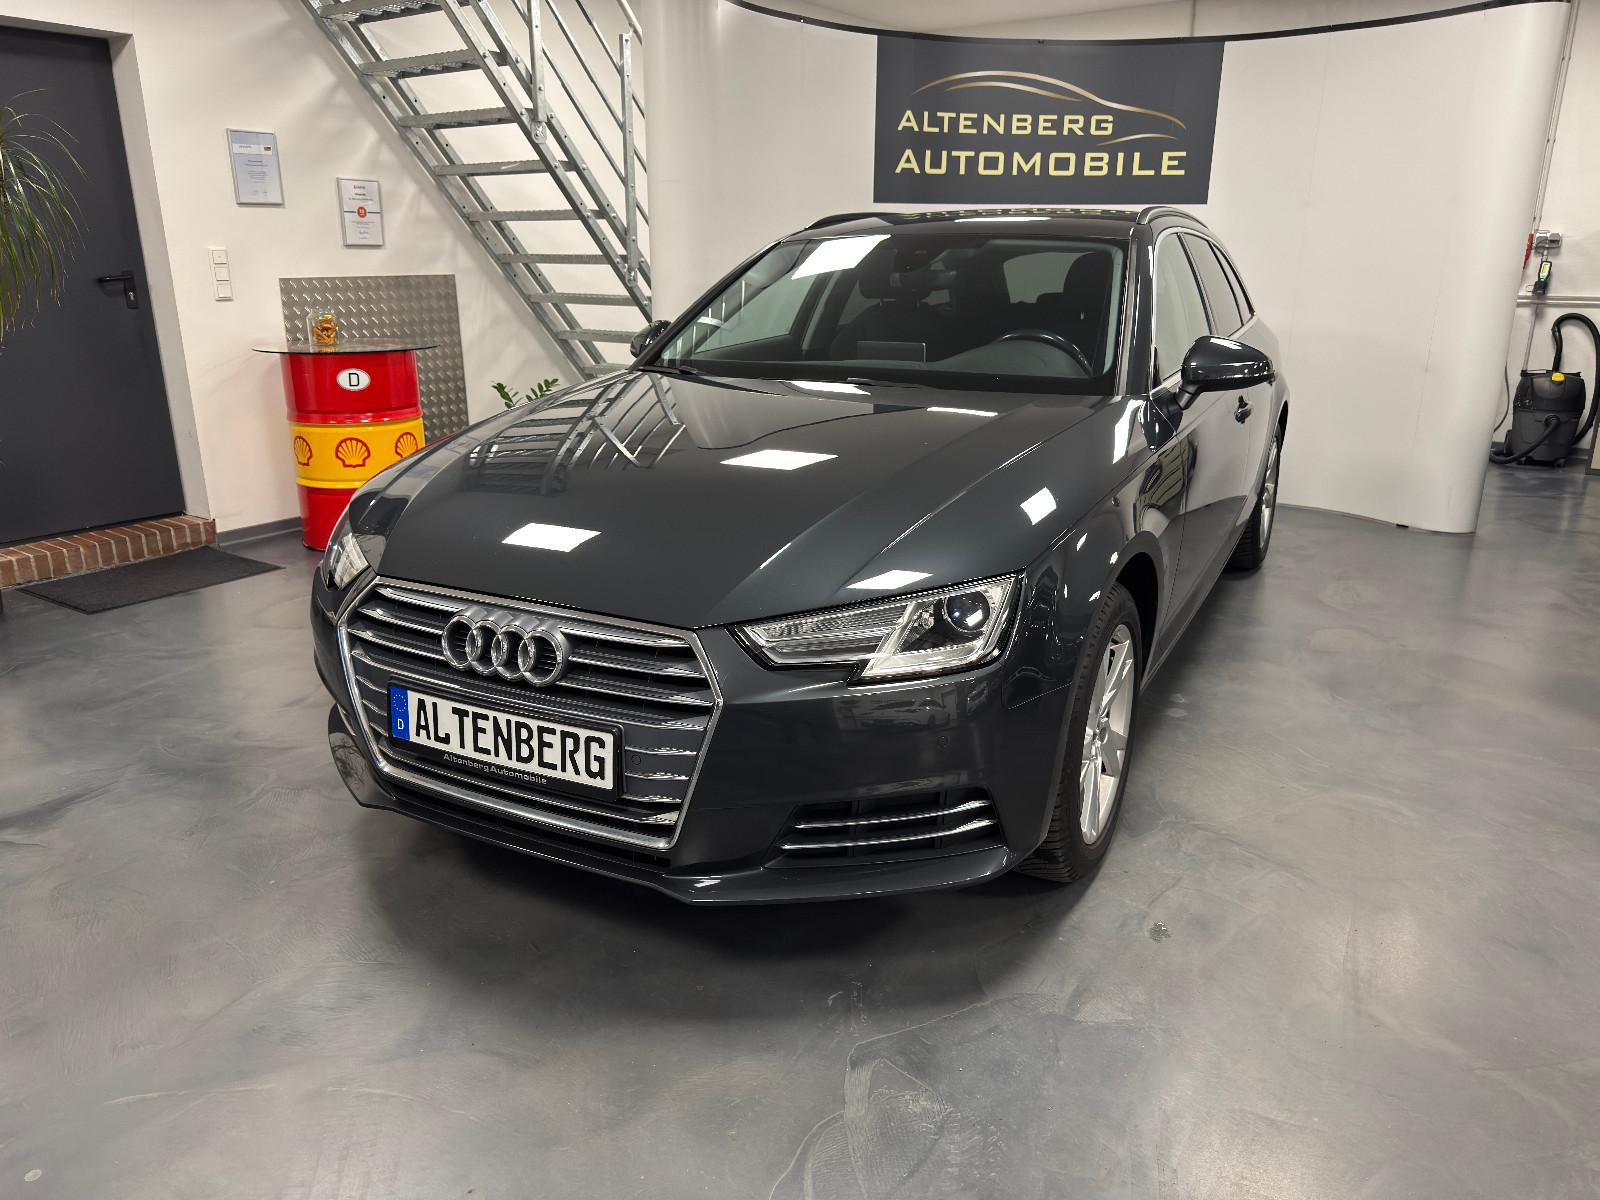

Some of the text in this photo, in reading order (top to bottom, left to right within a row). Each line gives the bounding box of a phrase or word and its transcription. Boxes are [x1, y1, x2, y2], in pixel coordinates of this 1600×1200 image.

[898, 110, 1114, 136] ALTENBERG
[895, 148, 1187, 176] AUTOMOBILE
[349, 373, 359, 387] D
[397, 718, 404, 730] D
[415, 697, 606, 781] ALTENBERG
